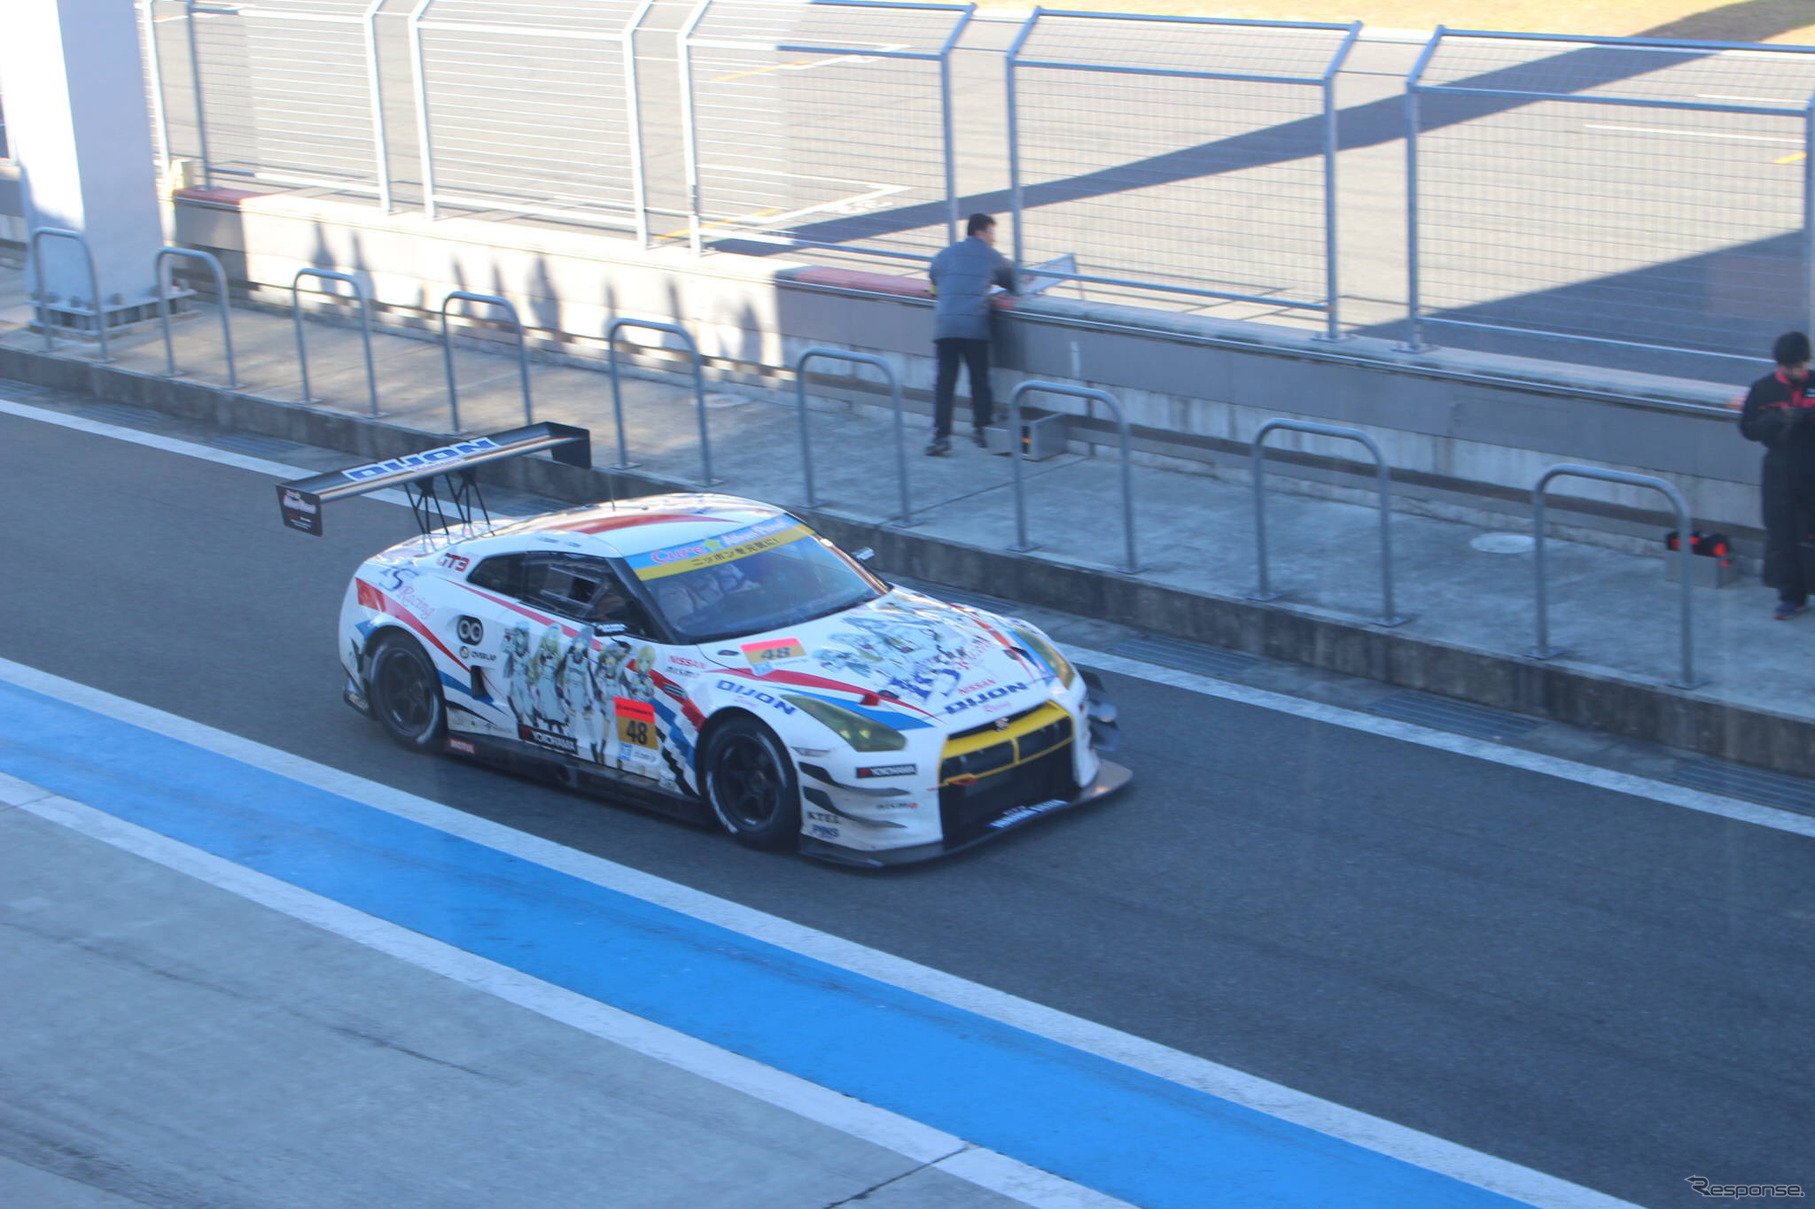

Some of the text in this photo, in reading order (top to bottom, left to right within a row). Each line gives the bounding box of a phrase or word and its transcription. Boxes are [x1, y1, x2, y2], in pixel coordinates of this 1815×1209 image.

[350, 440, 496, 479] DIJON
[437, 552, 470, 572] GT3
[652, 544, 705, 563] Cure
[760, 646, 791, 660] 48
[717, 679, 797, 715] DIJON
[944, 681, 1028, 715] DIJON
[626, 719, 649, 745] 48
